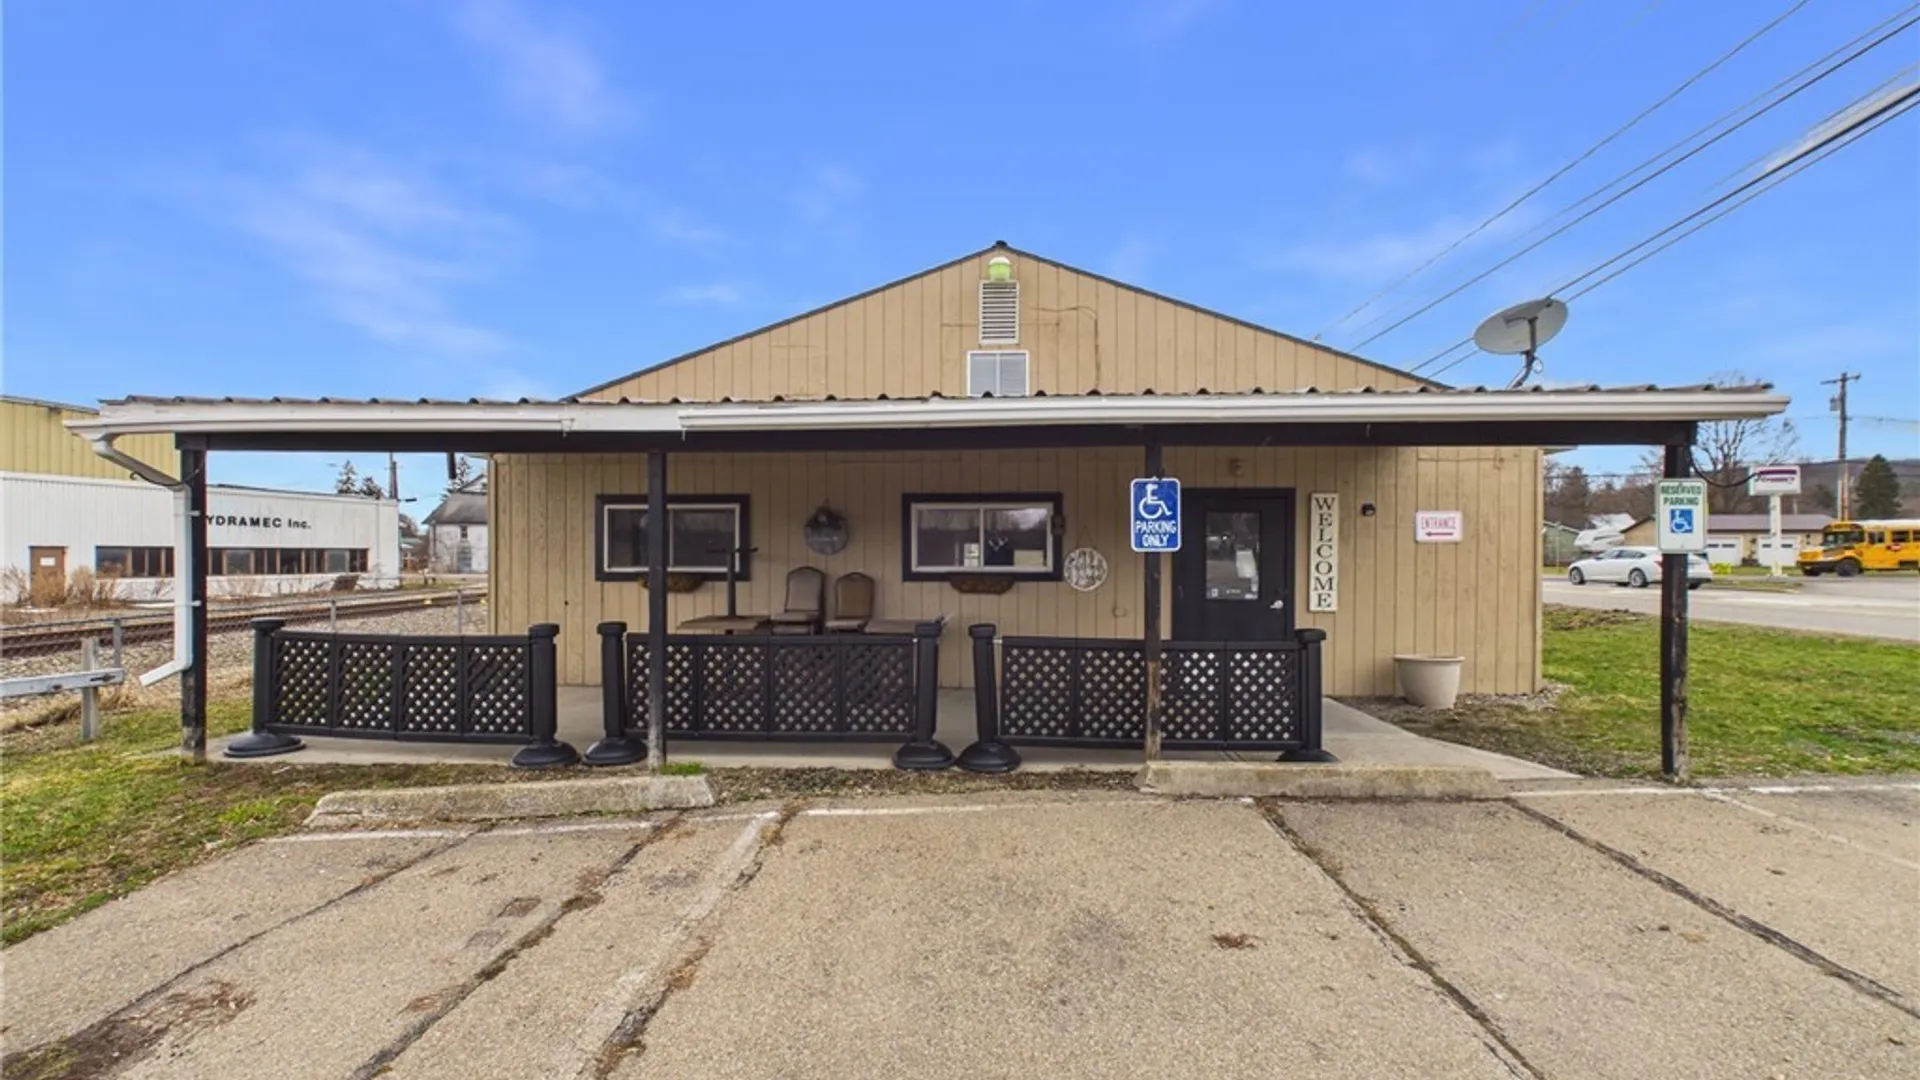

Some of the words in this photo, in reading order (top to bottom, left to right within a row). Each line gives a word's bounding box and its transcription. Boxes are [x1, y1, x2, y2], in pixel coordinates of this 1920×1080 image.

[1661, 485, 1702, 495] RESERVED
[1663, 496, 1699, 506] PARKING
[206, 515, 282, 528] YDRAMEC
[288, 518, 311, 529] Inc.
[1136, 520, 1177, 533] PARKING
[1420, 516, 1456, 529] ENTRANCE
[1142, 534, 1169, 547] ONLY
[1314, 496, 1336, 608] WELCOME
